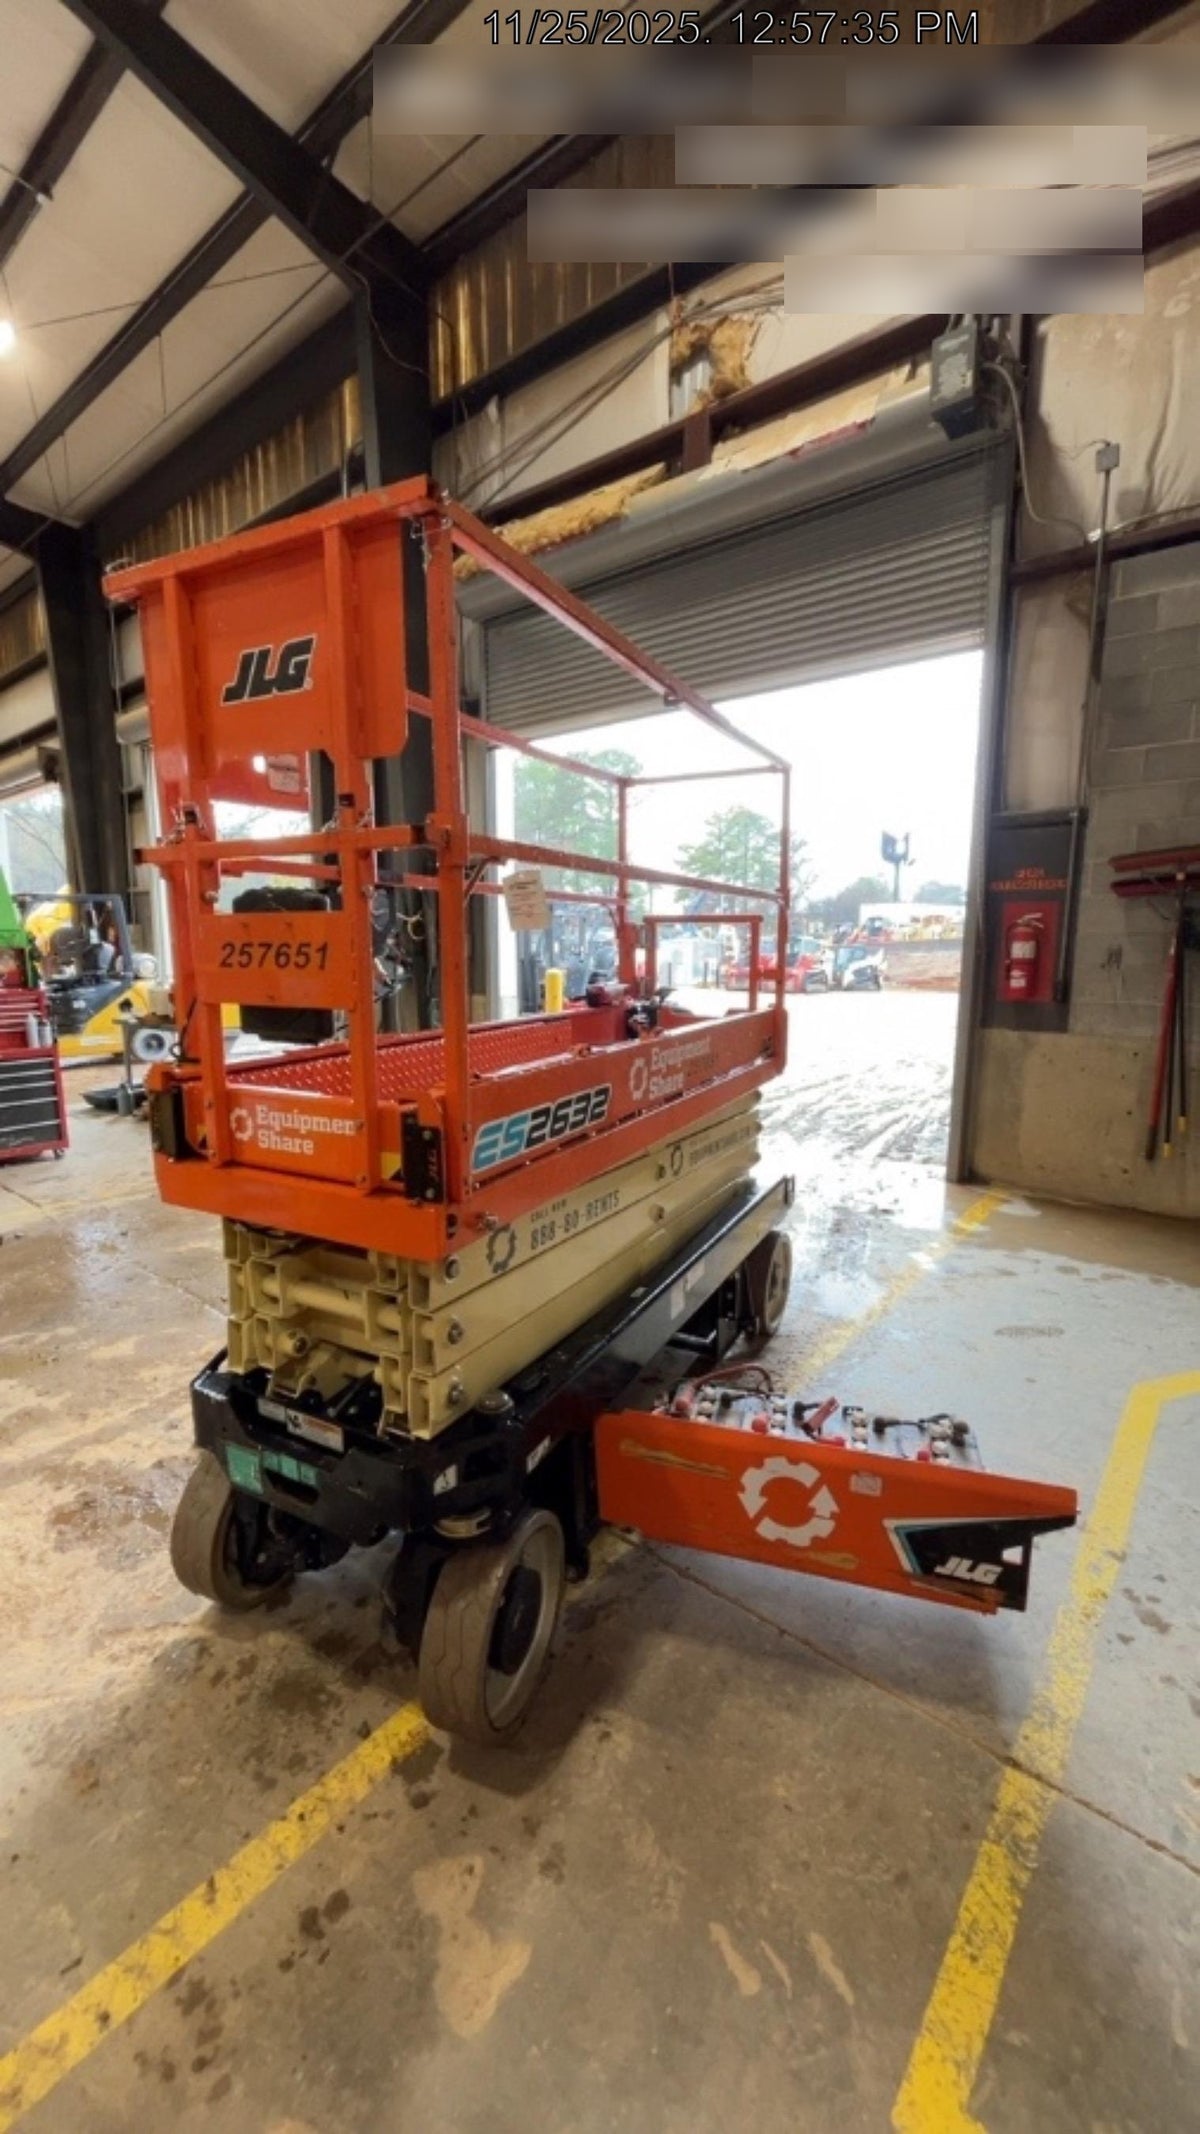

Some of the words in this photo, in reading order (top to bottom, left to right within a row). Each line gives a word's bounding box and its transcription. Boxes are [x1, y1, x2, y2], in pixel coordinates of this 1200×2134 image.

[221, 634, 316, 705] JLG
[219, 941, 328, 970] 257651
[651, 1036, 711, 1072] Equipment
[649, 1072, 684, 1100] Share
[255, 1103, 358, 1136] Equipmen
[470, 1083, 613, 1173] ES2632
[257, 1129, 315, 1155] Share
[934, 1555, 1003, 1586] JLG
